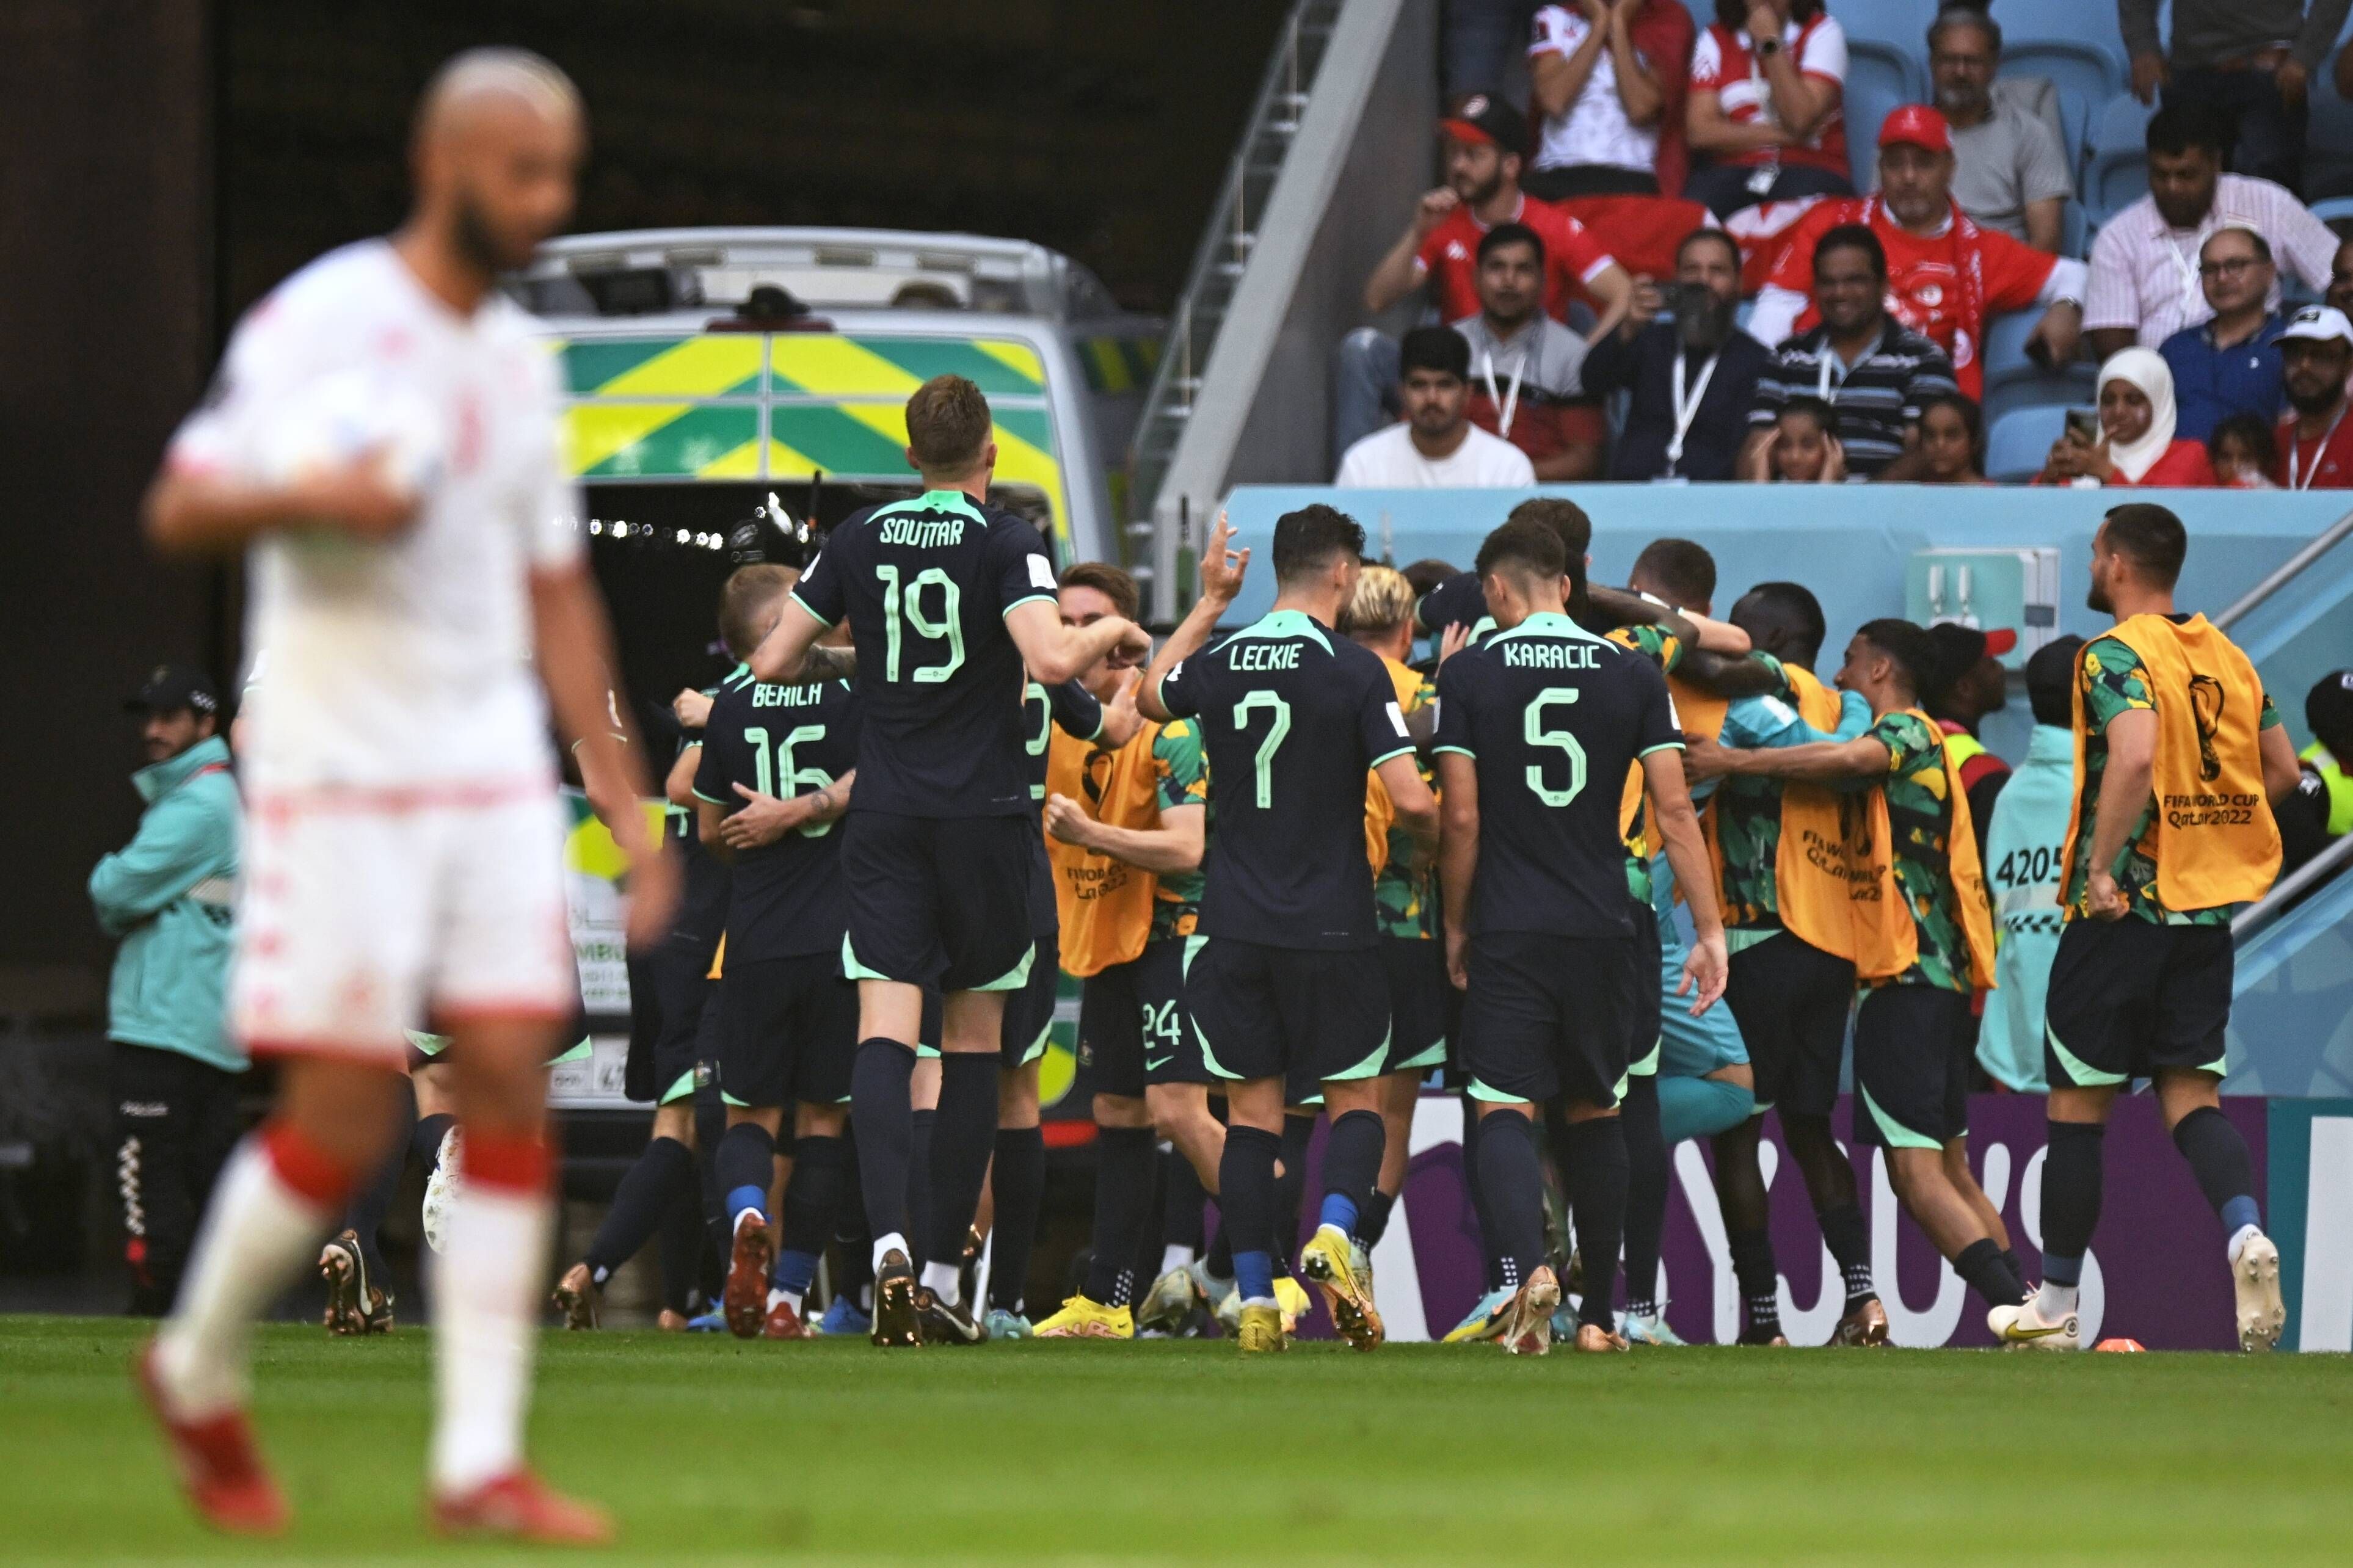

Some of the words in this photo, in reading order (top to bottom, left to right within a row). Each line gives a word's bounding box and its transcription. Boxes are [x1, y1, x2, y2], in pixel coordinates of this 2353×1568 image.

[879, 518, 965, 549] SOUTTAR
[876, 564, 965, 683] 19
[1229, 643, 1304, 670] LECKIE
[1504, 642, 1601, 669] KARACIC
[1234, 689, 1290, 808] 7
[1524, 688, 1587, 807] 5
[744, 724, 835, 838] 16
[2164, 795, 2191, 808] FIFA
[2231, 794, 2259, 807] CUP
[1142, 999, 1182, 1050] 24
